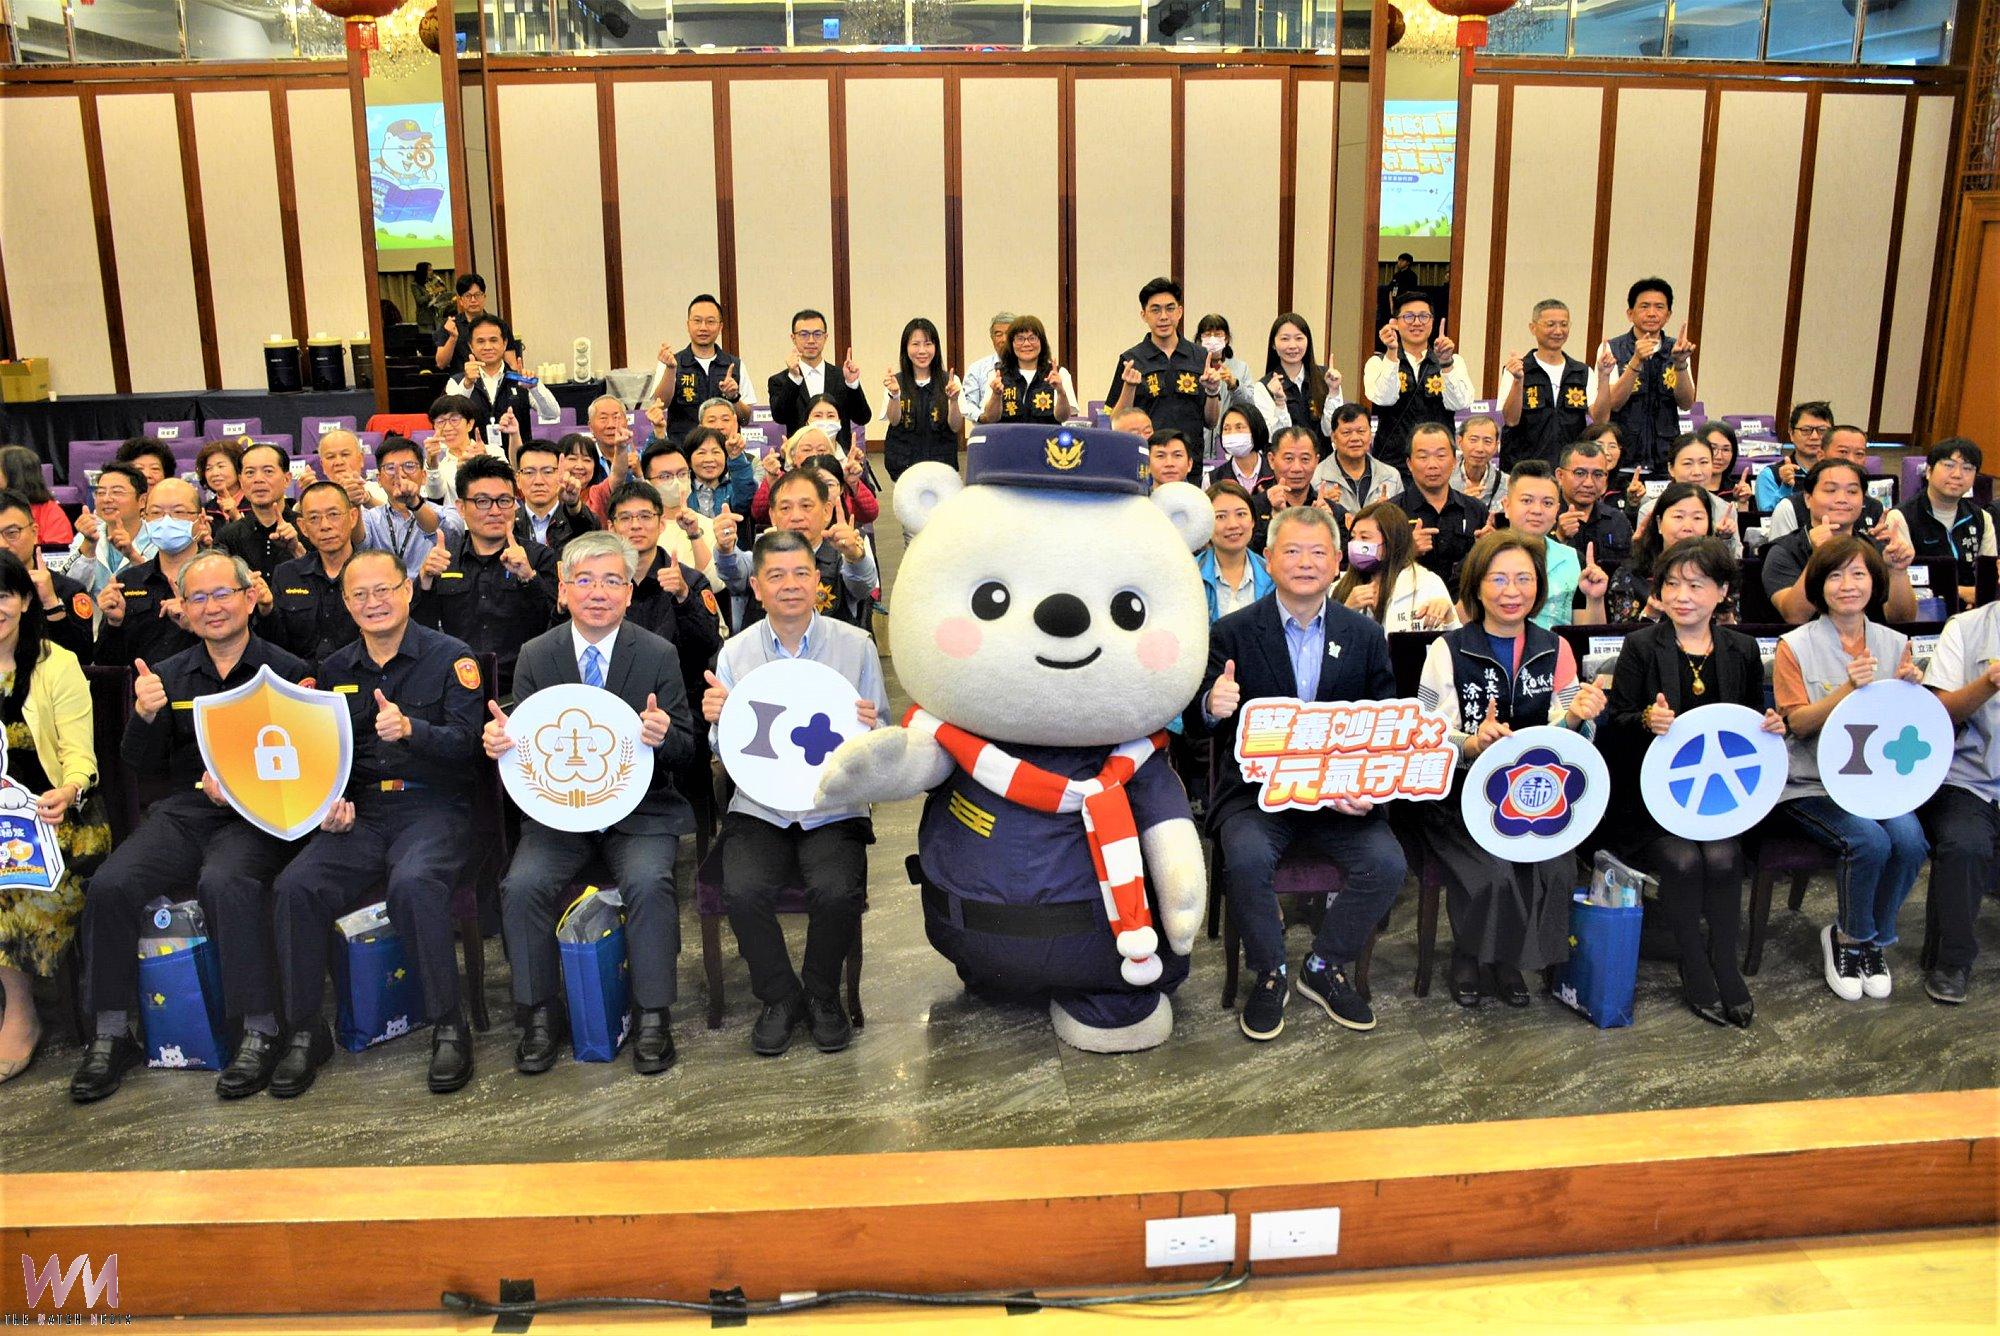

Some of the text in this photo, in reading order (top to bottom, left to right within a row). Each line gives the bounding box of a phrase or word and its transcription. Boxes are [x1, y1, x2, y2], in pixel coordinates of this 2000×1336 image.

[681, 374, 697, 402] 刑警
[1004, 387, 1018, 416] 刑警
[1266, 751, 1451, 801] 元氣守護
